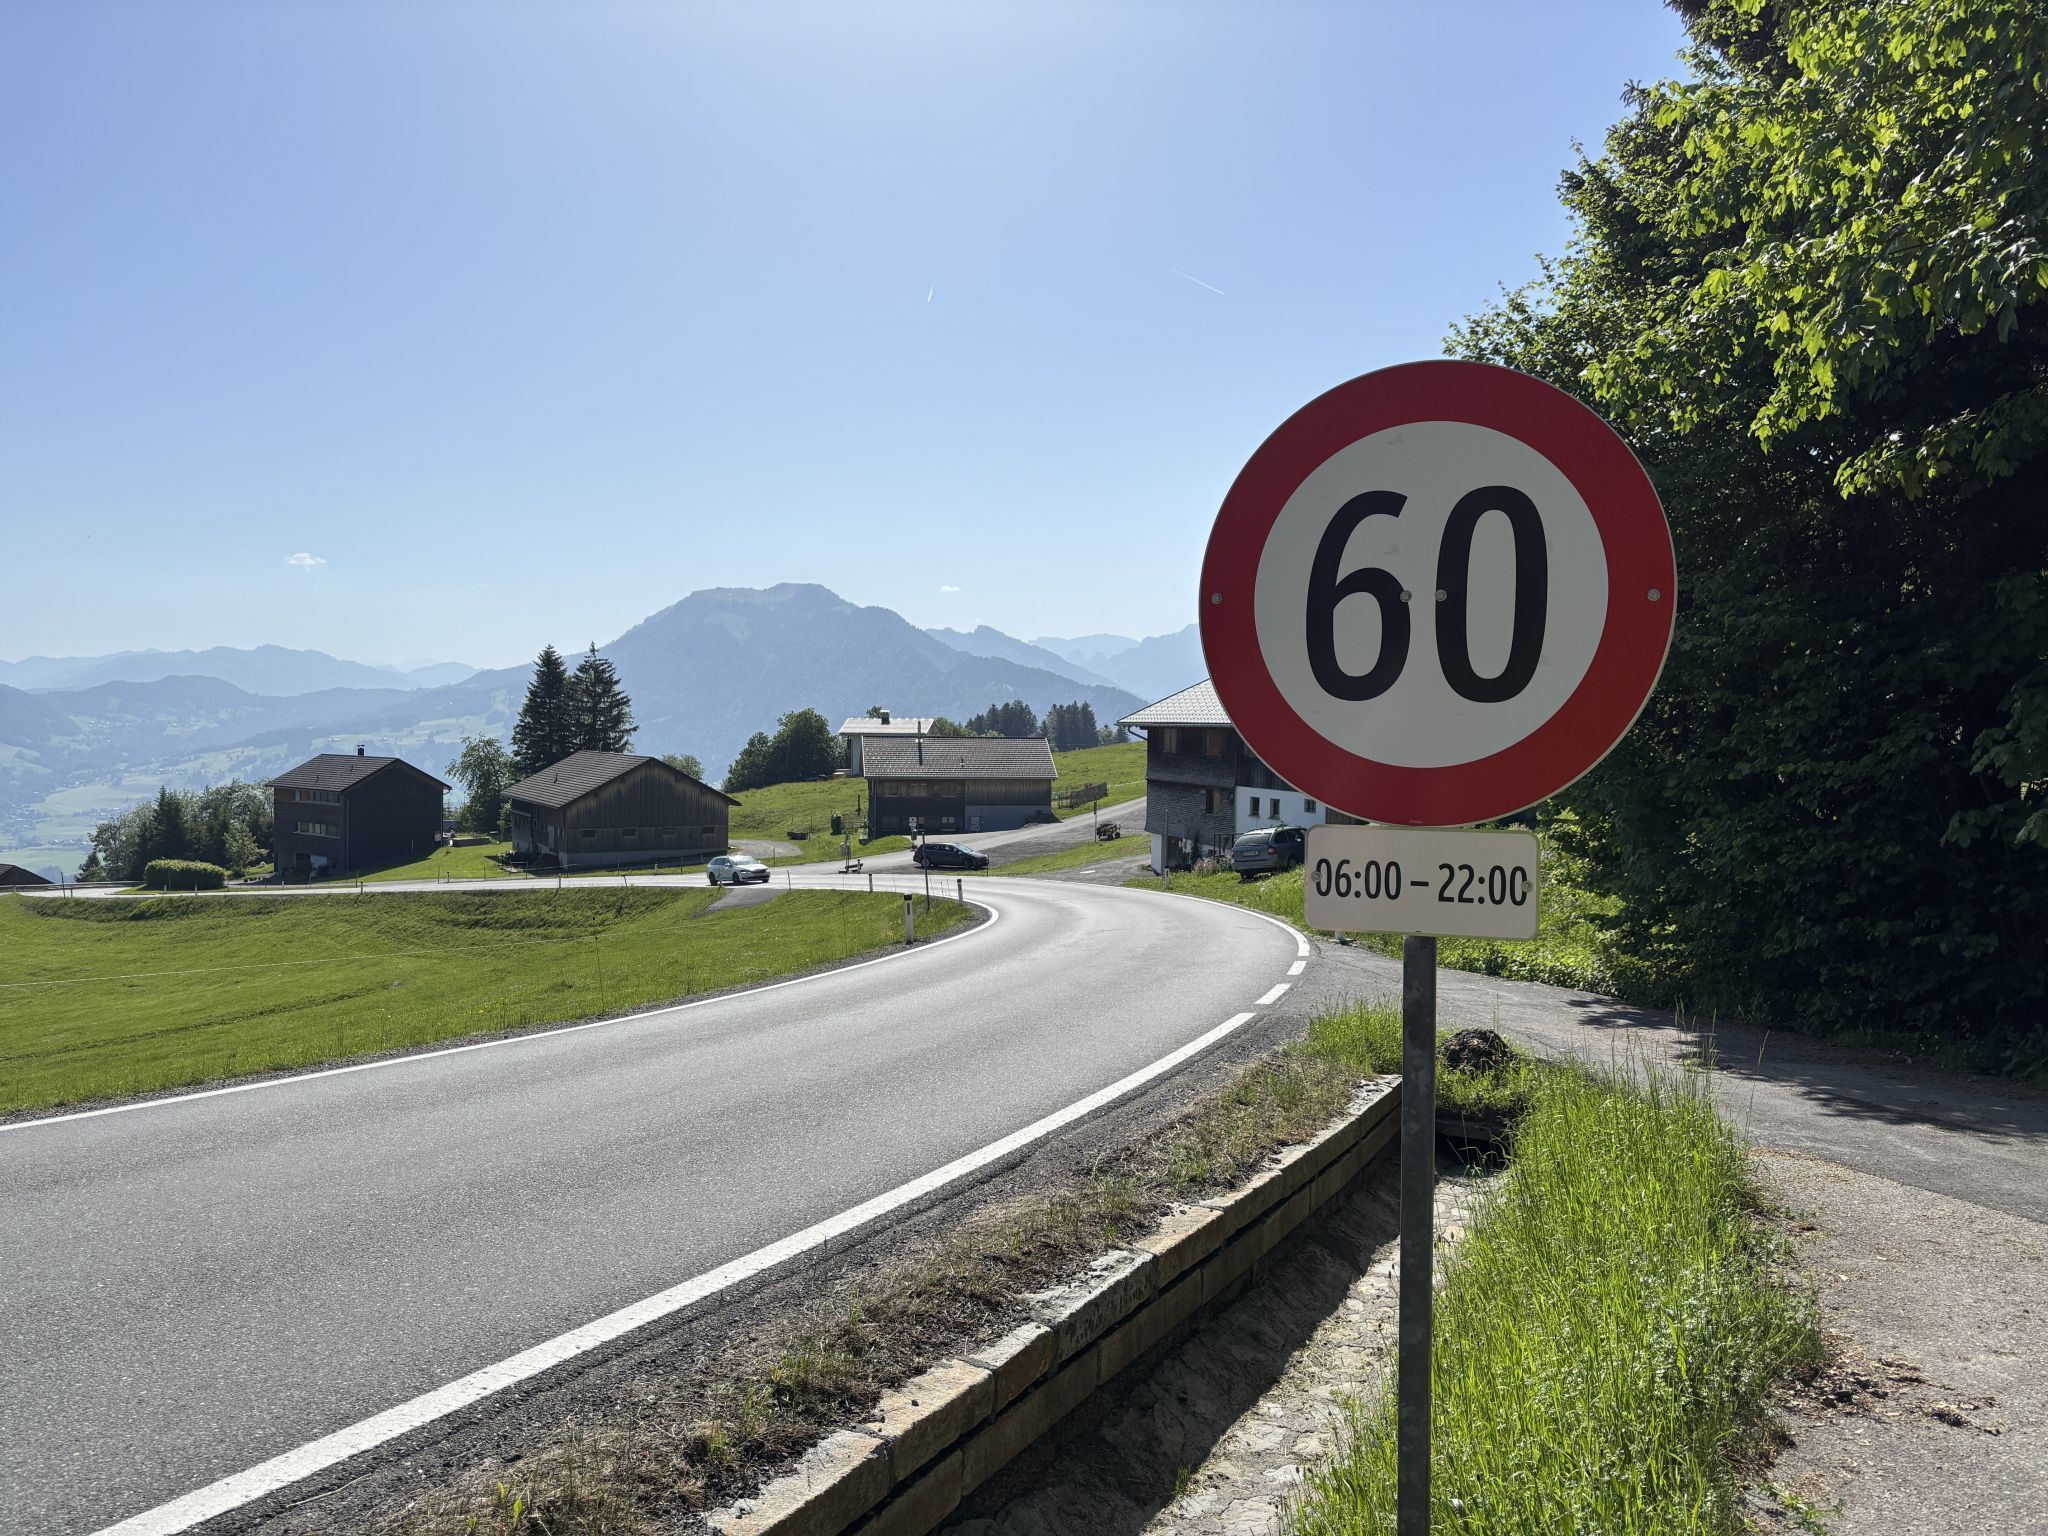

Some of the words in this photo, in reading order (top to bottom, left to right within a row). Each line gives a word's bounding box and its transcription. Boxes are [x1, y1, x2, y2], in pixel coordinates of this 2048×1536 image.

[1306, 485, 1549, 704] 60
[1315, 858, 1402, 901] 06:00
[1438, 863, 1529, 906] 22:00
